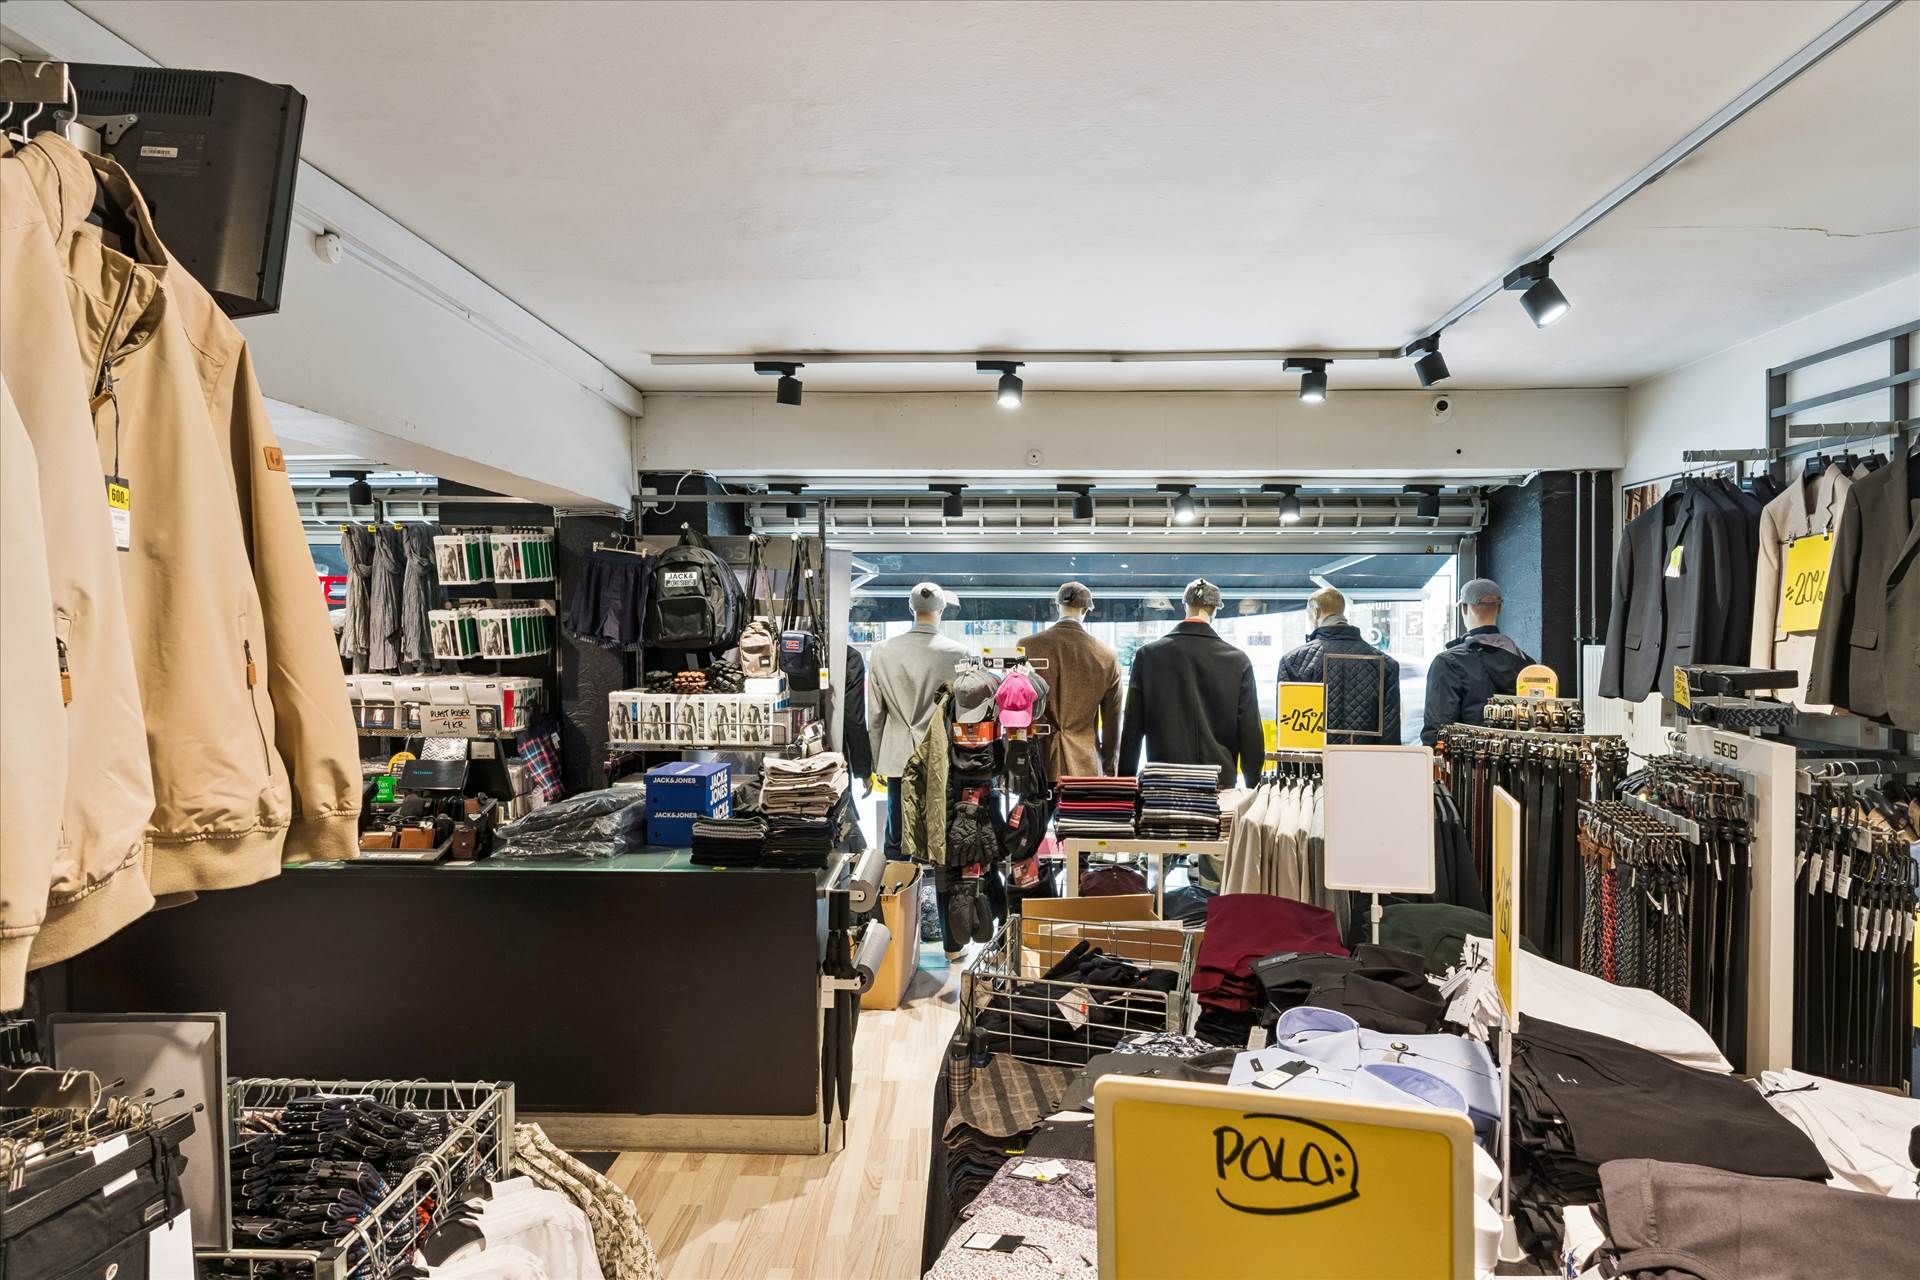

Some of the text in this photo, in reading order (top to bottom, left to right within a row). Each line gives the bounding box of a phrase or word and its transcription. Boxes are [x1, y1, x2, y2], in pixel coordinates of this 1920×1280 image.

[442, 720, 467, 730] 4 KR
[1280, 708, 1325, 733] ÷25%
[710, 783, 728, 806] JONES
